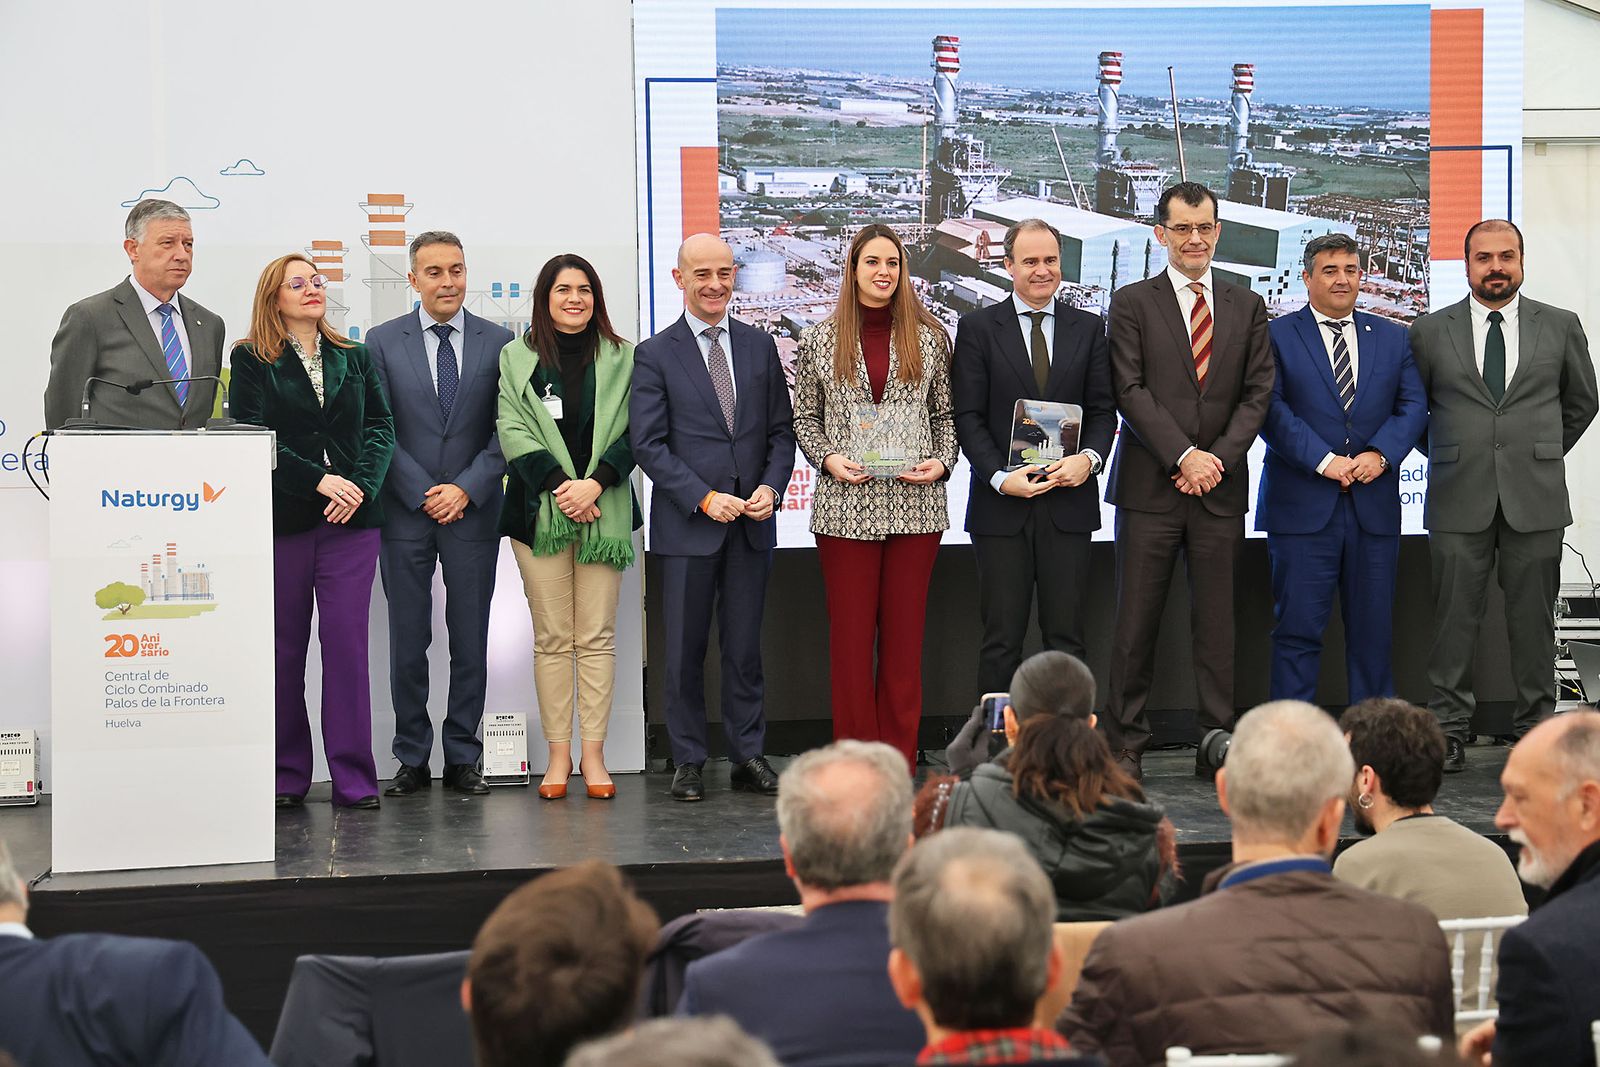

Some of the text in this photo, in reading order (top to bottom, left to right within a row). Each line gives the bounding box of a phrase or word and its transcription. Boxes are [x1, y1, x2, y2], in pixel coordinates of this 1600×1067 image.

[101, 489, 199, 512] Naturgy
[140, 633, 160, 643] Ani
[104, 633, 140, 658] 20
[140, 647, 169, 657] sario
[104, 669, 170, 682] Central de
[104, 682, 209, 696] Ciclo Combinado
[105, 696, 225, 709] Palos de la Frontera
[105, 718, 142, 728] Huelva
